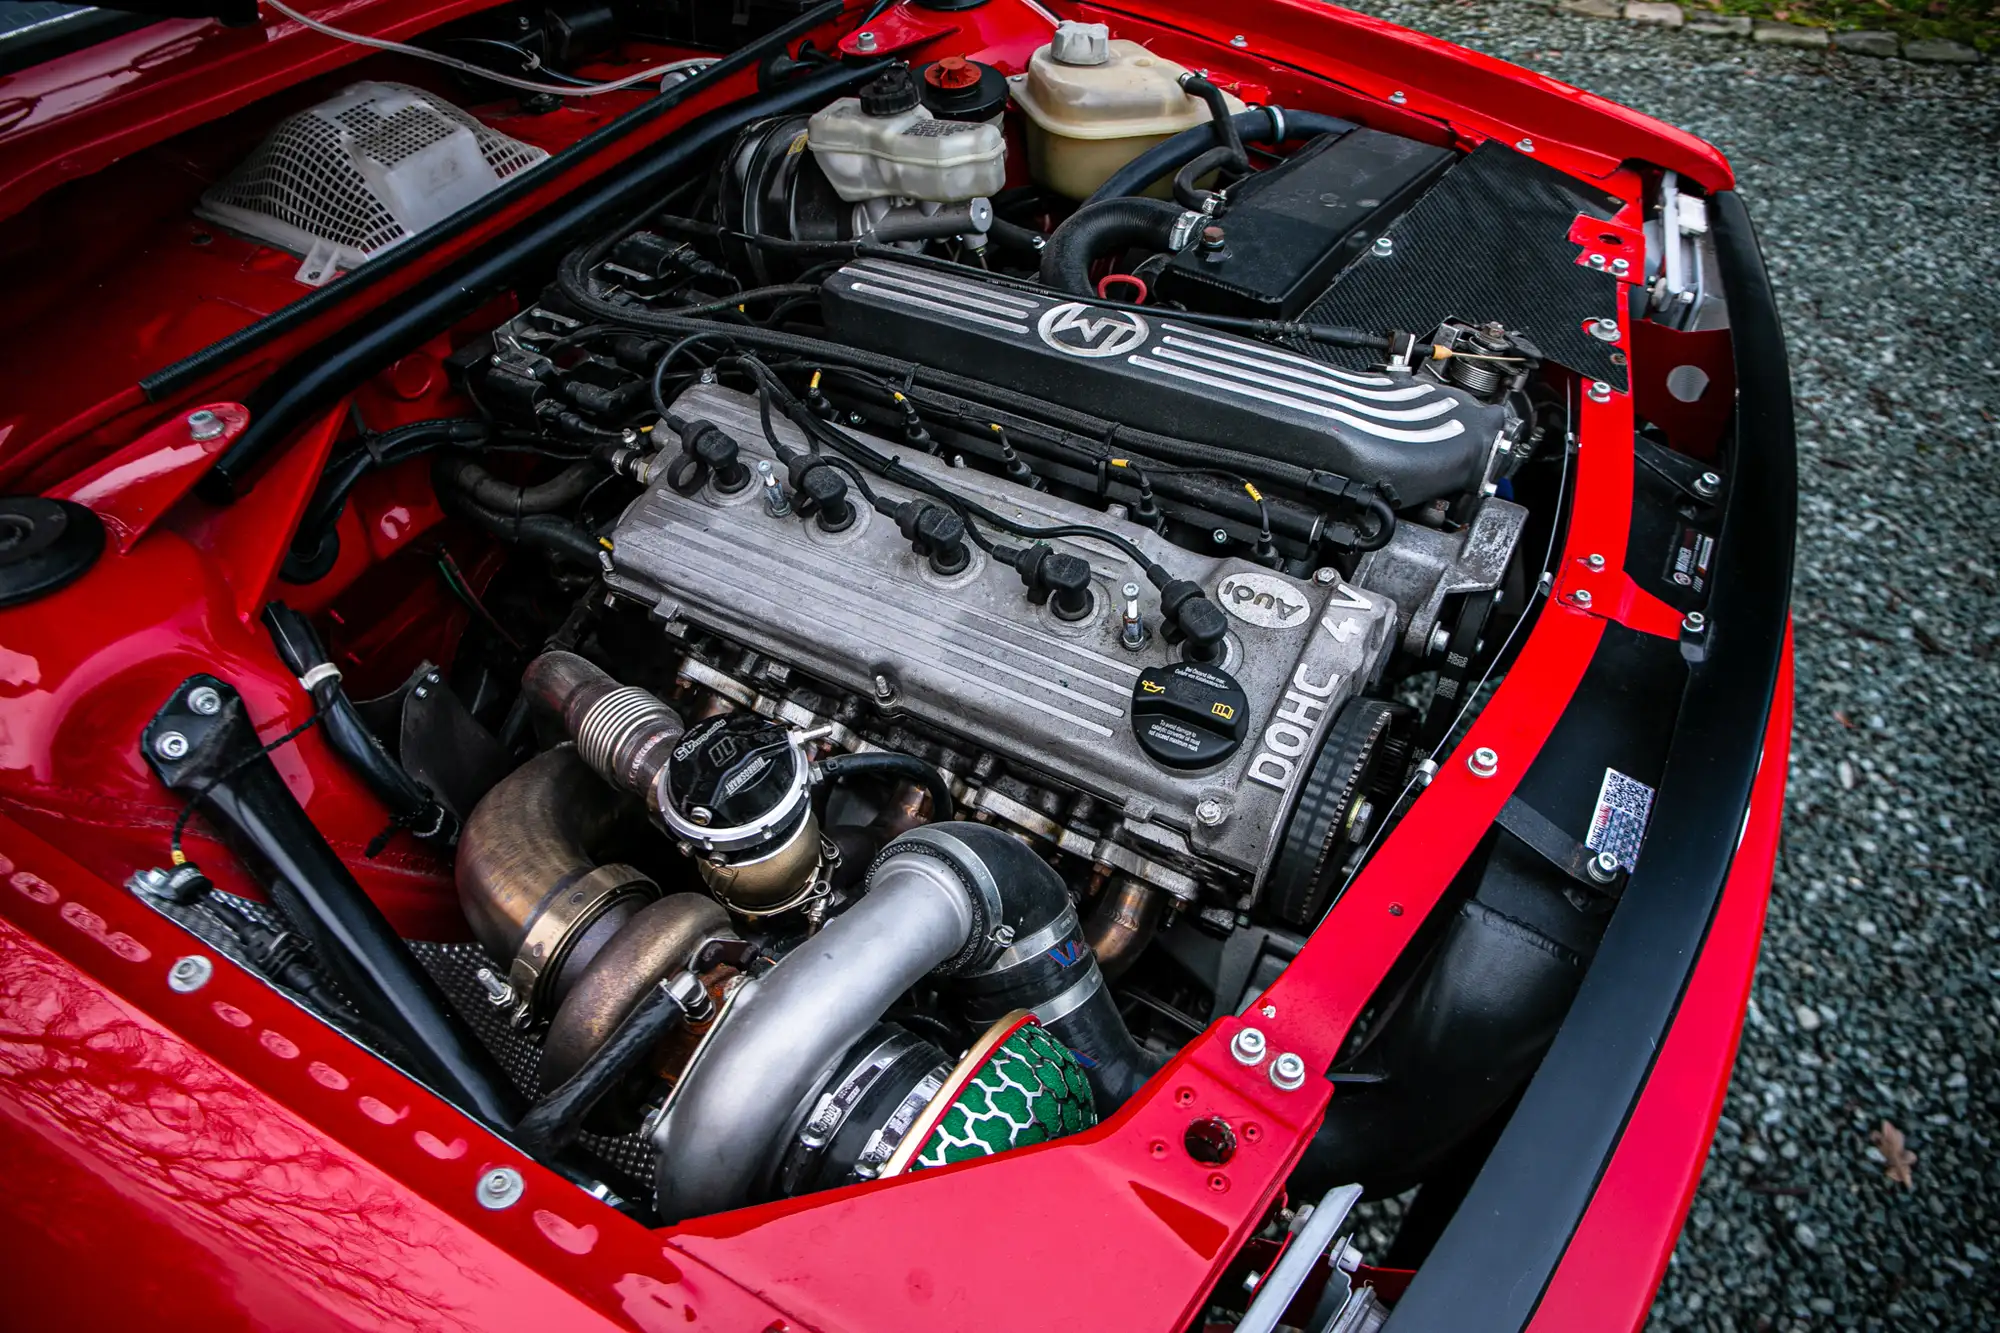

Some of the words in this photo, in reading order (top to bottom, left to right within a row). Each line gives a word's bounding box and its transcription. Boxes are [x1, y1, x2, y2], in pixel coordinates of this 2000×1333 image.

[1222, 580, 1305, 621] Audi
[1247, 662, 1341, 791] DOHC
[1320, 583, 1373, 643] 4V
[725, 756, 771, 795] TURBOSMART
